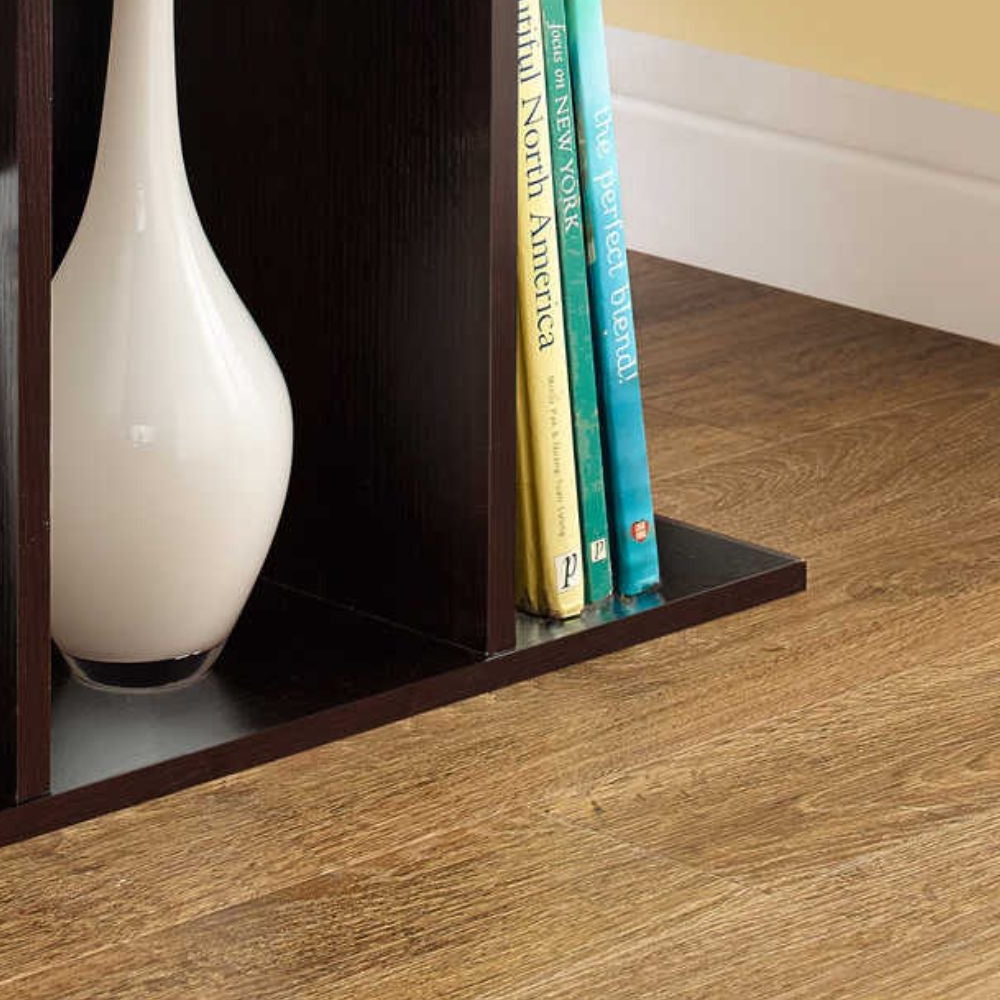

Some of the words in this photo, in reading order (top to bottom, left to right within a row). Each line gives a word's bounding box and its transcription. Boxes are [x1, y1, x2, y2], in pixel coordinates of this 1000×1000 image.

[522, 95, 549, 199] North
[555, 96, 572, 152] NEW
[594, 107, 613, 159] the
[560, 158, 580, 231] YORK
[593, 168, 625, 278] perfect
[530, 213, 555, 352] America
